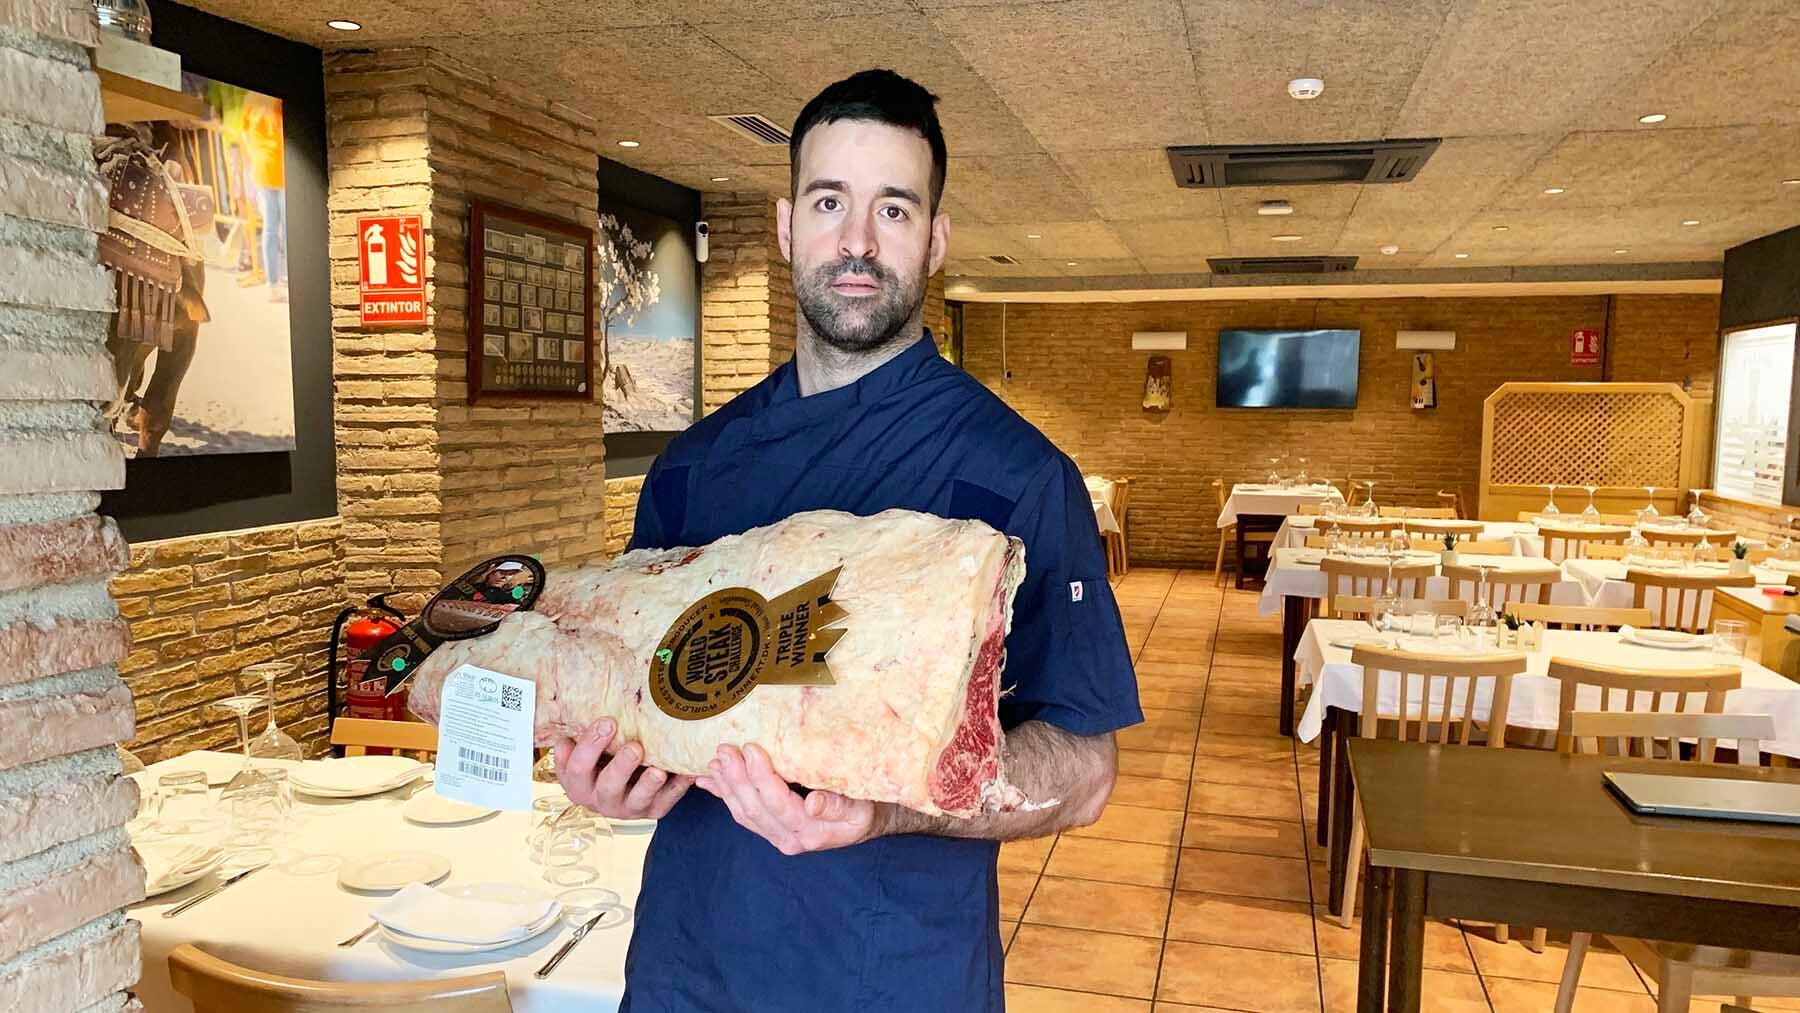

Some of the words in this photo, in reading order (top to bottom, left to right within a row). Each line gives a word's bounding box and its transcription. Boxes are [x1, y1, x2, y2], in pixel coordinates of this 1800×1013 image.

[364, 301, 421, 314] EXTINTOR
[667, 604, 708, 649] PRODUCER
[729, 623, 743, 674] CHALLENGE
[775, 610, 795, 665] TRIPLE
[790, 600, 810, 668] WINNER
[685, 635, 707, 686] WORLD
[703, 622, 732, 685] STEAK
[661, 686, 676, 705] BEST
